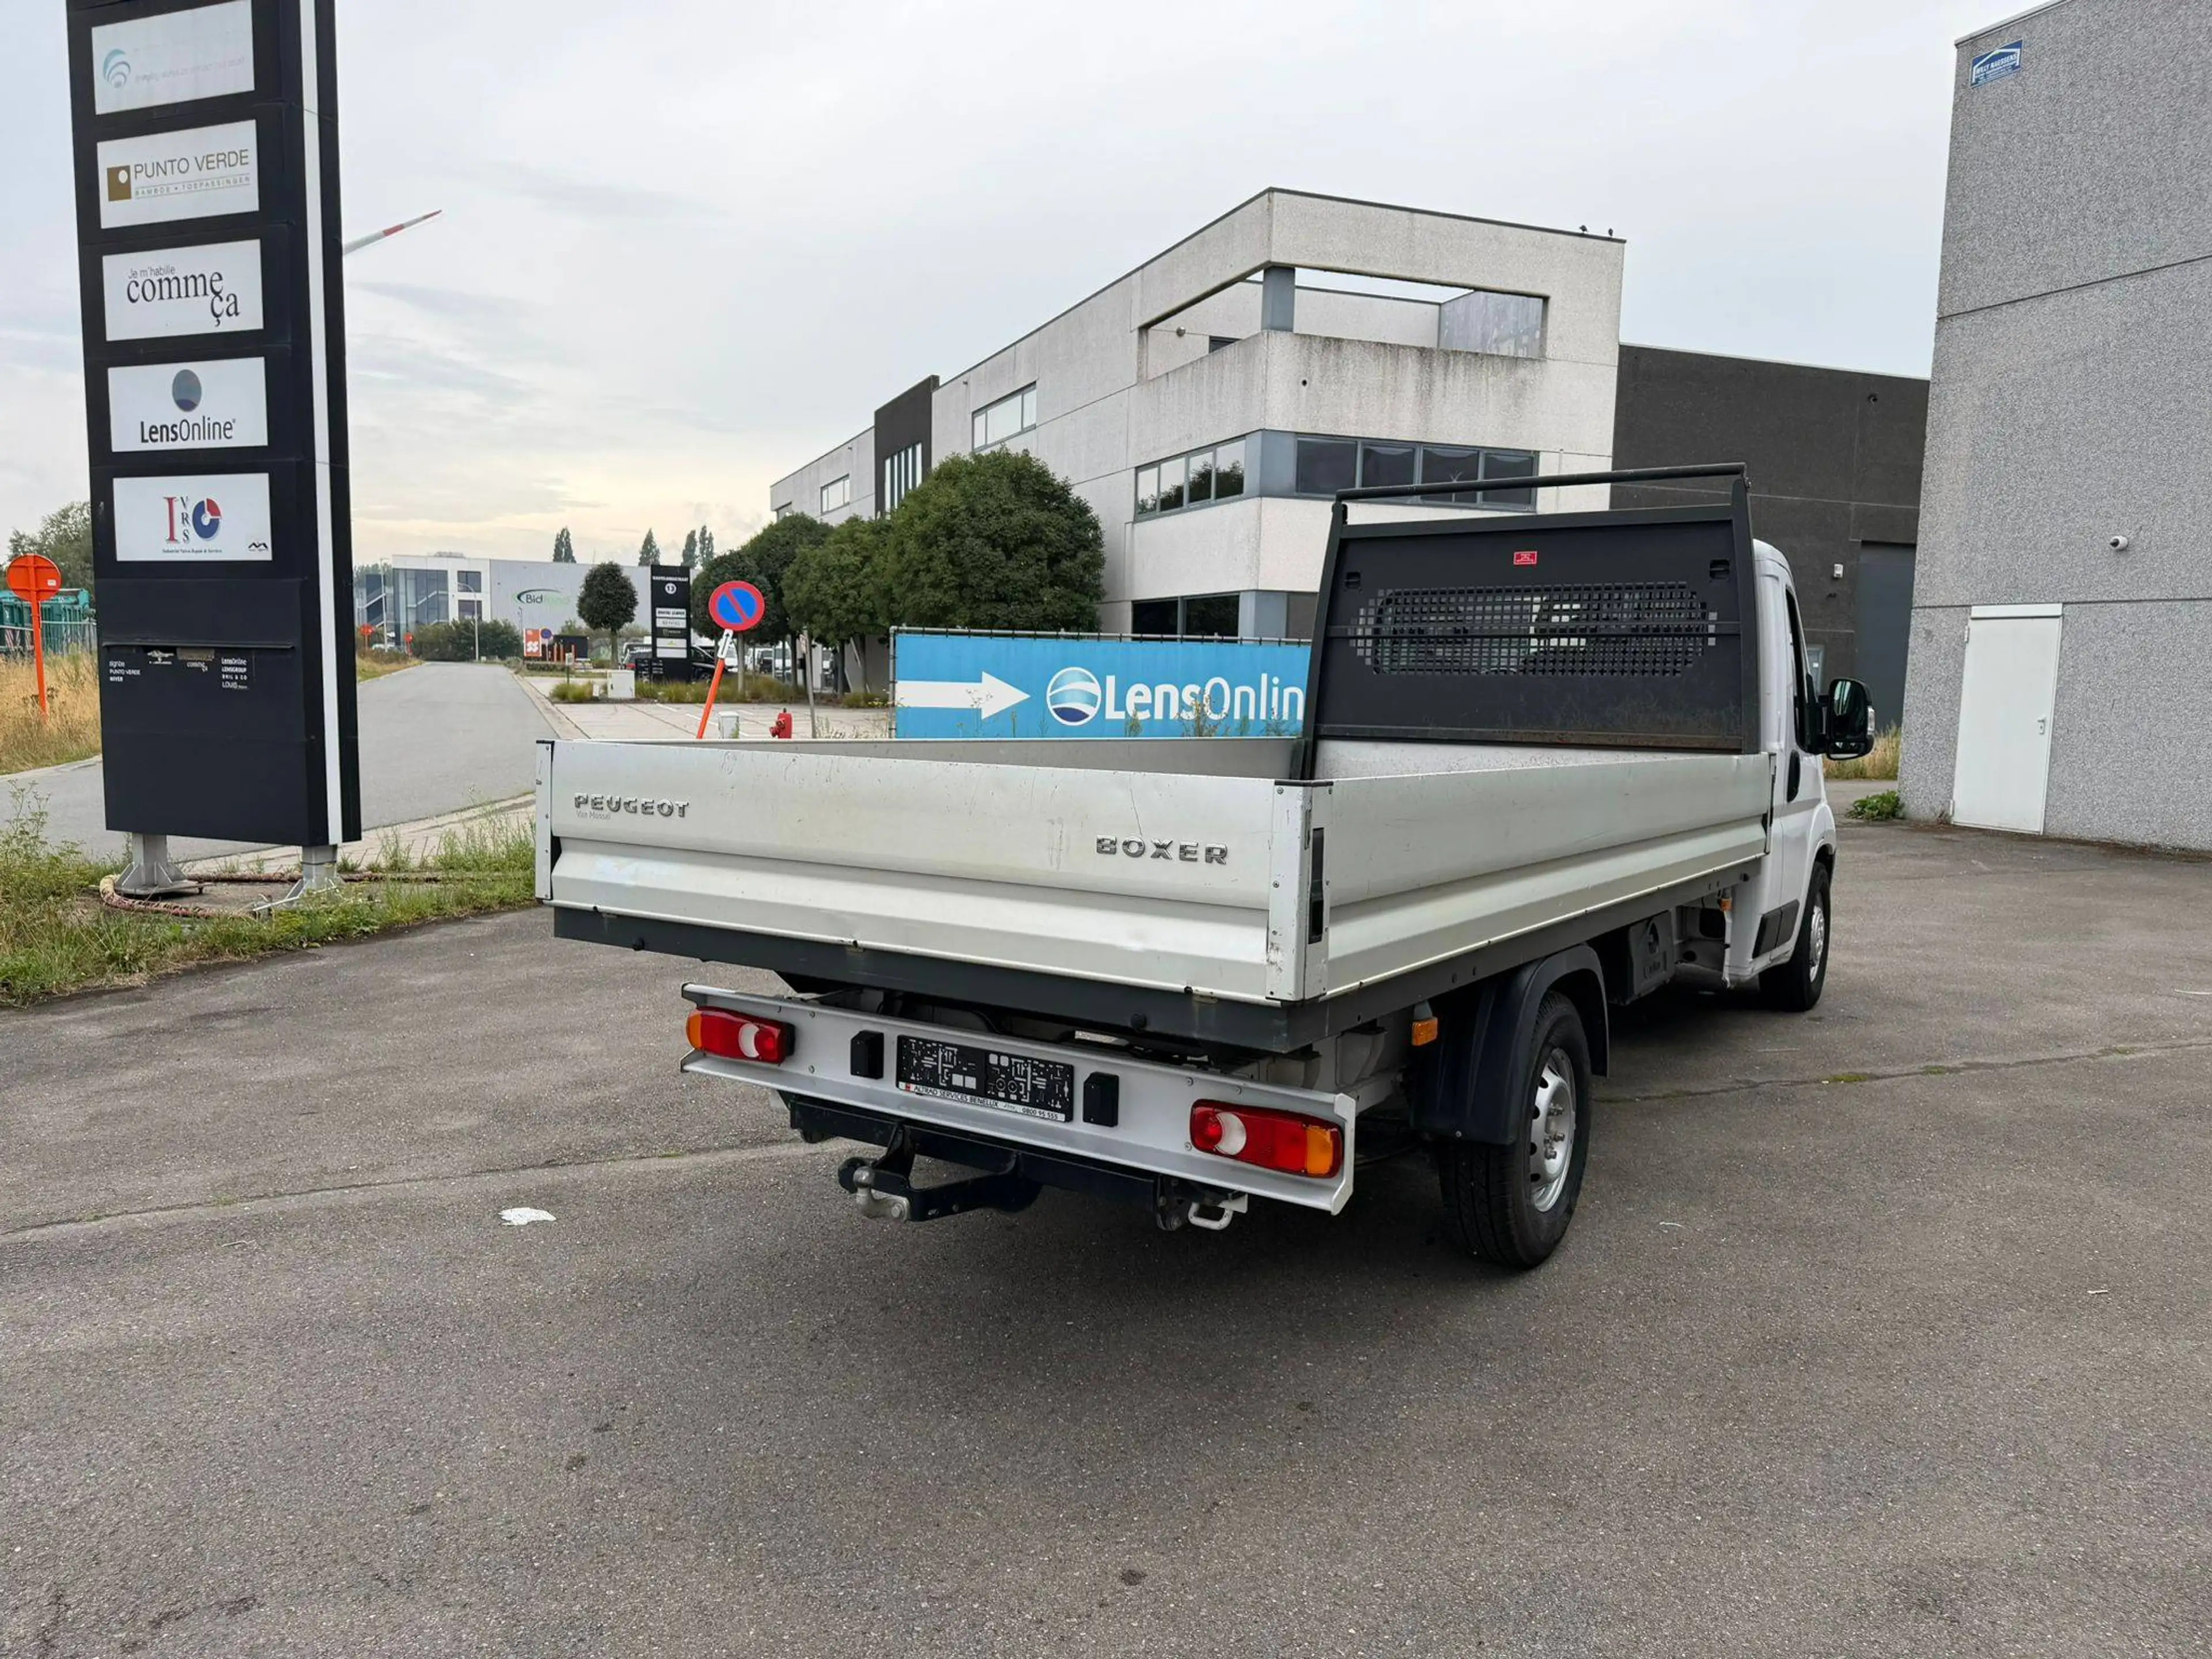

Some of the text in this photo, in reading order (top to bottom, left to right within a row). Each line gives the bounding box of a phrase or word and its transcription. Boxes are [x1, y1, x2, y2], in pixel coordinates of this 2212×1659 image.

[134, 149, 249, 180] PUNTO VERDE
[182, 176, 251, 190] TOEPASSINGEN
[140, 264, 175, 278] m'habille
[127, 272, 224, 304] comme
[210, 293, 241, 327] ça
[141, 415, 233, 444] LensOnline
[1105, 673, 1305, 721] LensOnlin
[574, 793, 690, 818] PEUGEOT
[1096, 835, 1228, 865] BOXER
[914, 1085, 937, 1095] ALTRAD
[940, 1089, 968, 1101] SERVICES
[969, 1095, 998, 1107] BENELUX
